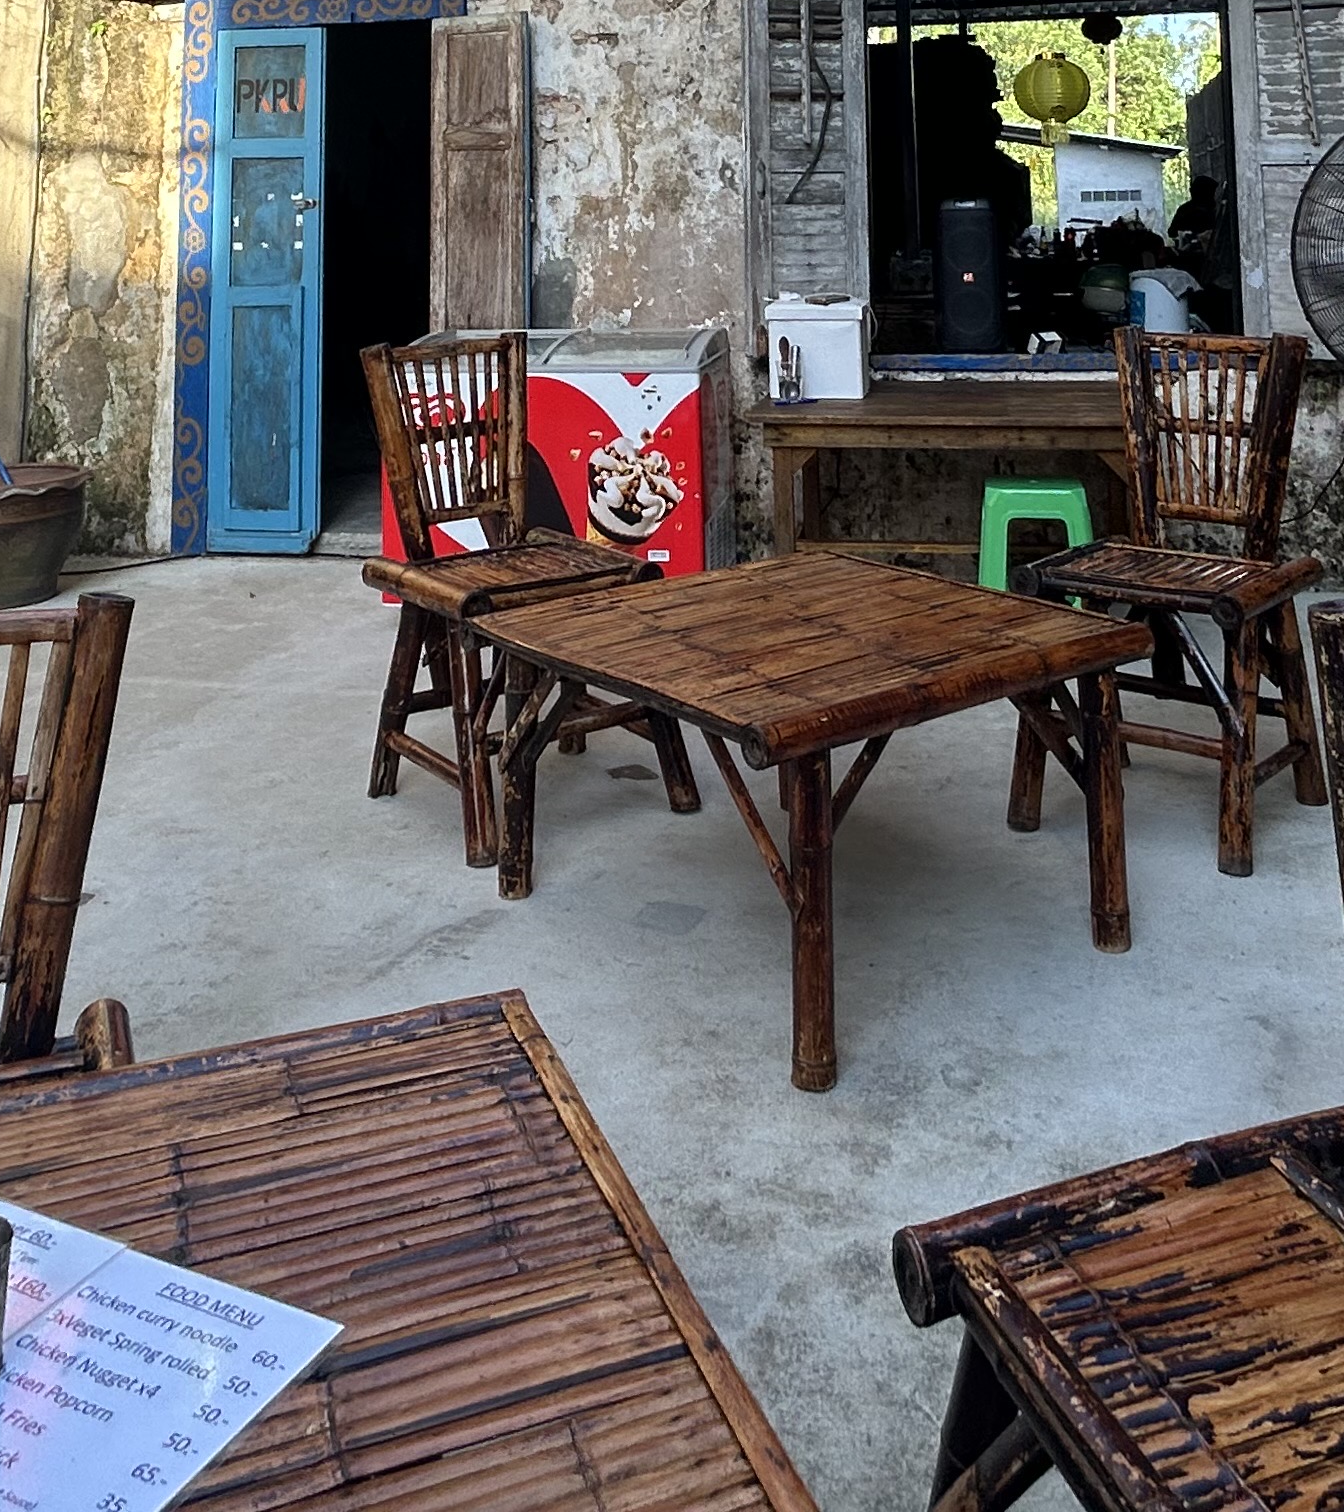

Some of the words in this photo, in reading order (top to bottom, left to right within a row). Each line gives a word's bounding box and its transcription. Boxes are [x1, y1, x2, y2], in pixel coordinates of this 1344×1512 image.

[77, 1285, 136, 1316] Chicken
[136, 1308, 180, 1332] curry
[179, 1324, 239, 1354] noodle
[251, 1350, 285, 1372] 60.-
[160, 1282, 208, 1308] FOOD
[212, 1299, 265, 1327] MENU
[16, 1334, 78, 1368] Chicken
[77, 1357, 138, 1391] Nugget
[137, 1384, 161, 1399] x4
[192, 1404, 229, 1426] 50.-
[111, 1332, 157, 1364] Spring
[161, 1353, 212, 1381] rolled
[223, 1375, 258, 1398] 50.-
[3, 1408, 48, 1437] Fries
[44, 1384, 113, 1423] Popcorn
[162, 1432, 198, 1456] 50.-
